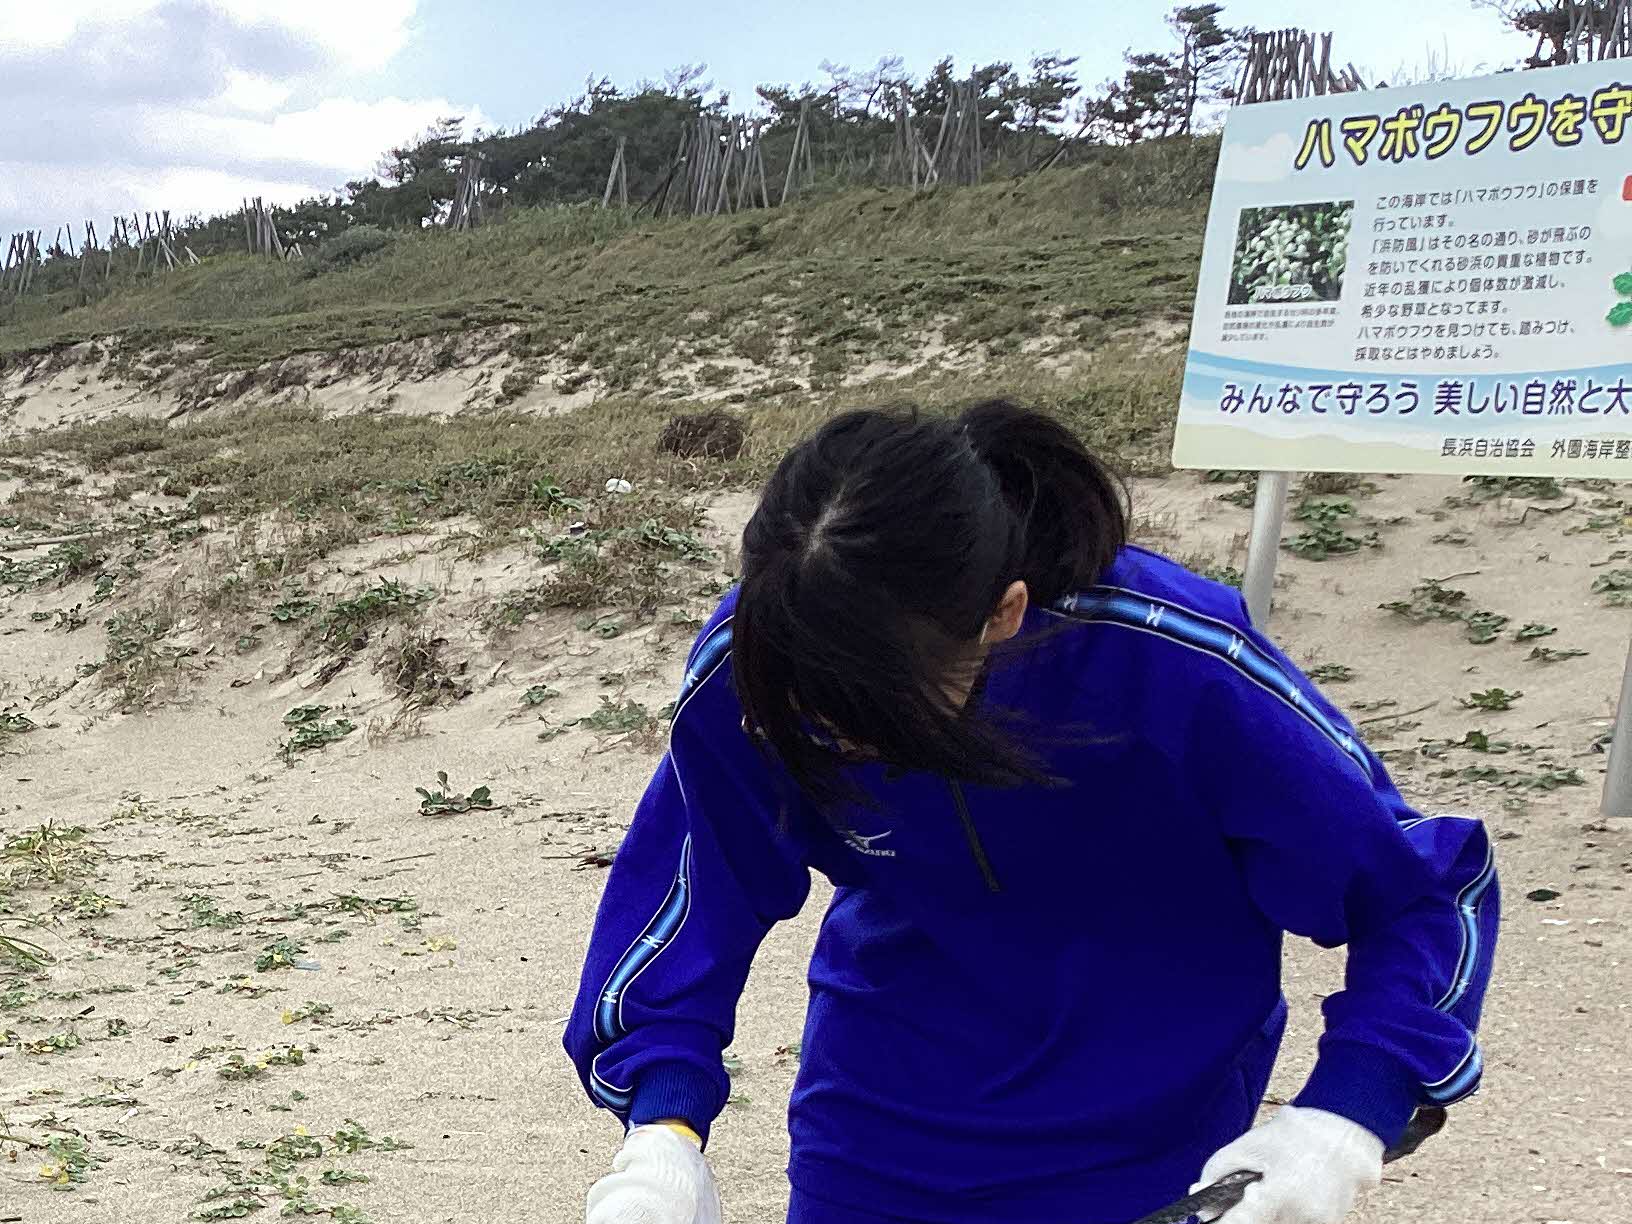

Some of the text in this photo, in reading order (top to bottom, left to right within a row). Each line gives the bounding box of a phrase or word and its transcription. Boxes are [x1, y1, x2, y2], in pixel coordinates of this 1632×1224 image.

[1294, 81, 1632, 170] ハマボウフウを守
[1373, 213, 1455, 232] 行っています。
[1360, 300, 1509, 319] 希少な野草となってます。
[1354, 344, 1500, 362] 採取などはやめましょう。
[1220, 379, 1632, 416] みんなで守ろう 美しい自然と大
[1441, 437, 1536, 458] 長浜自治協会
